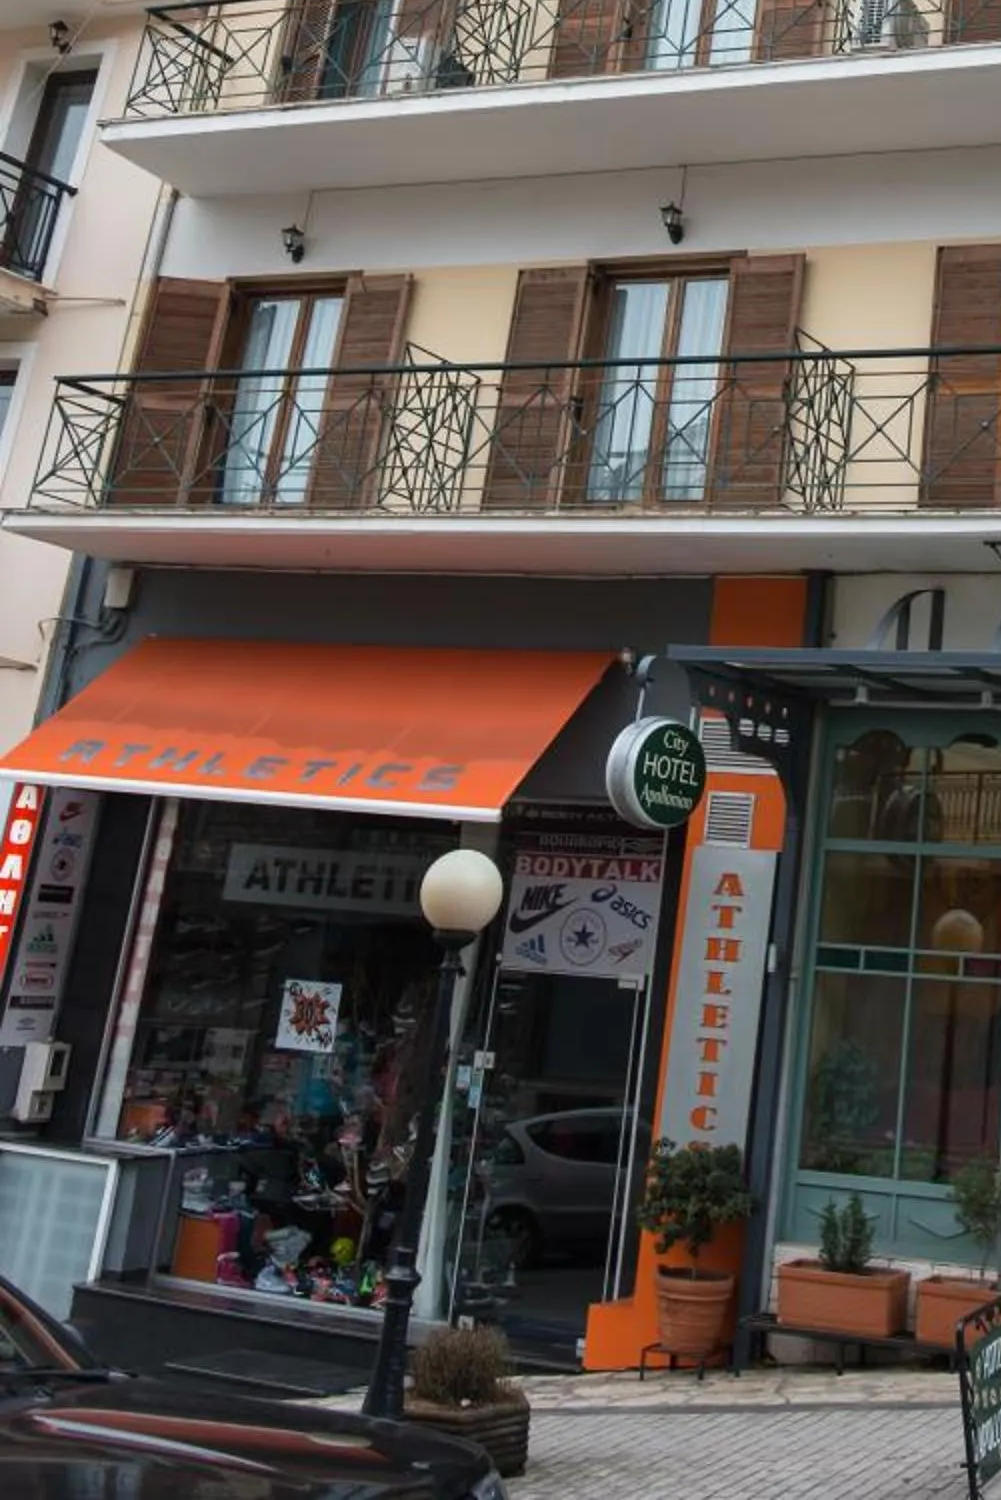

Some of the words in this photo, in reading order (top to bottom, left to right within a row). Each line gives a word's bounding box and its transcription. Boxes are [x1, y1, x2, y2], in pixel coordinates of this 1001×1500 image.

[663, 729, 690, 757] City
[60, 740, 467, 792] ATHLETICS
[643, 751, 699, 787] HOTEL
[242, 855, 420, 903] ATHLETI
[514, 855, 660, 882] BODYTALK
[520, 883, 568, 912] NIKE
[610, 897, 652, 930] asics
[688, 873, 744, 1152] ATHLETIC
